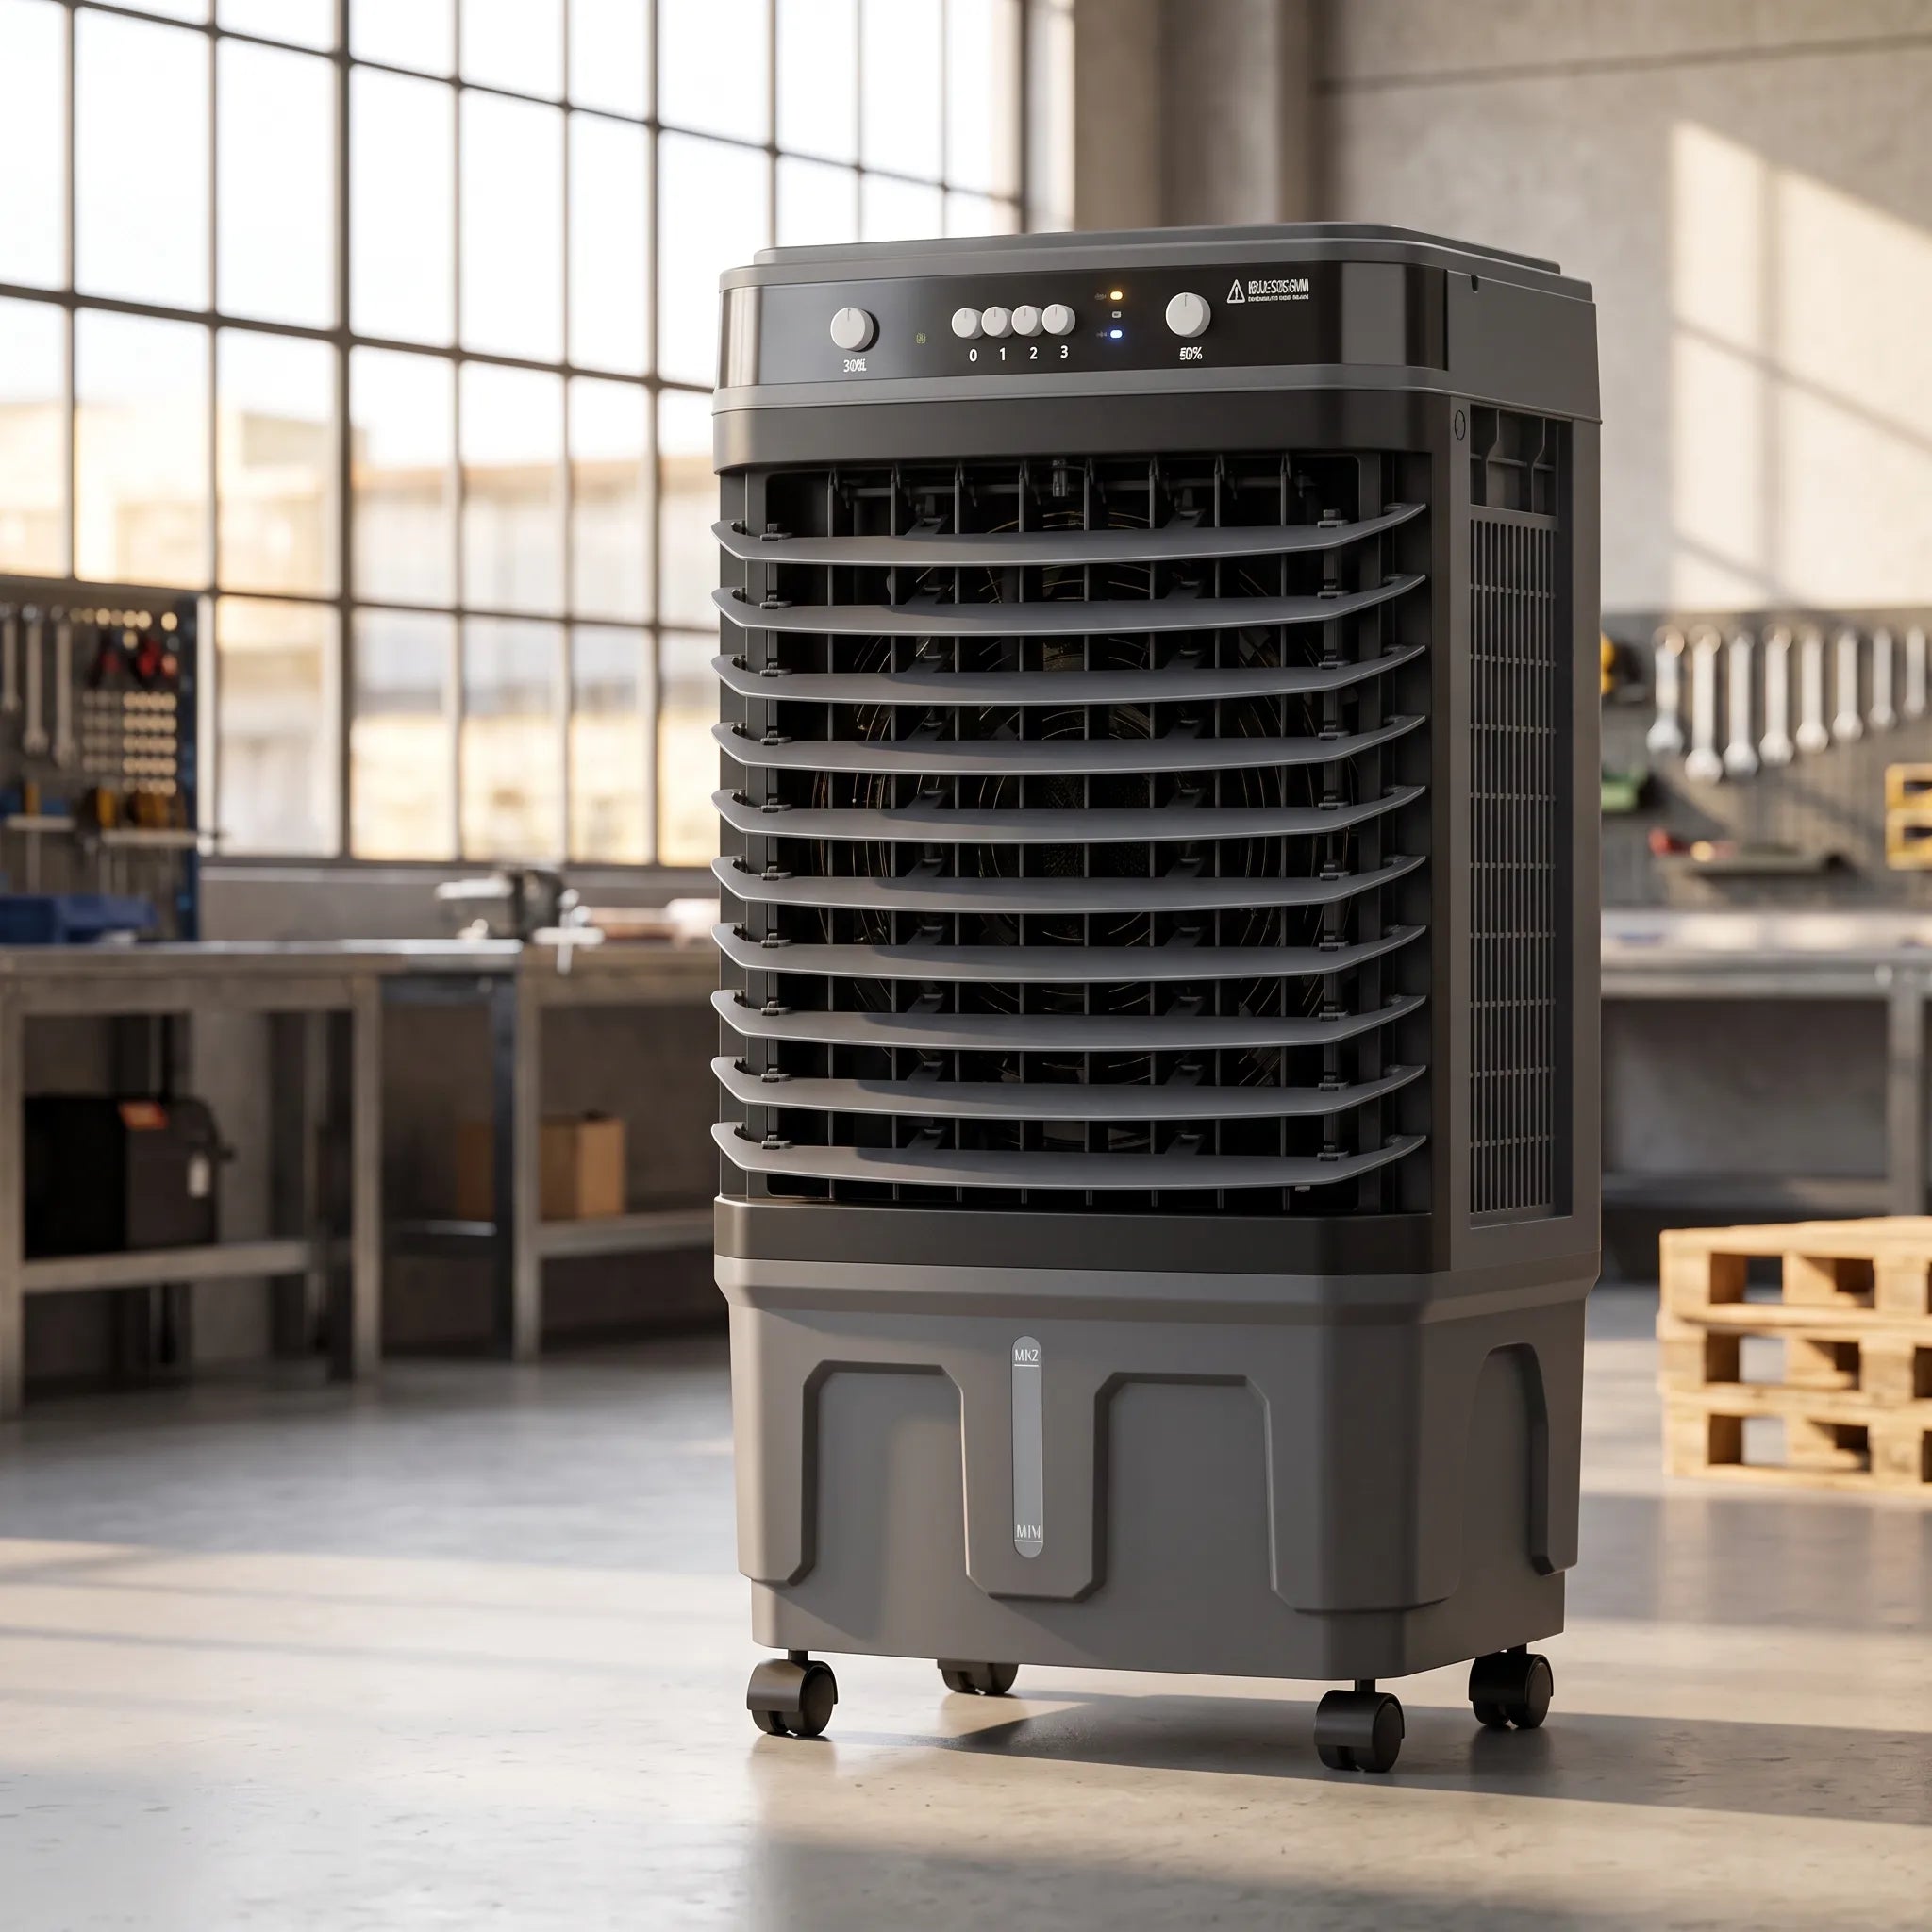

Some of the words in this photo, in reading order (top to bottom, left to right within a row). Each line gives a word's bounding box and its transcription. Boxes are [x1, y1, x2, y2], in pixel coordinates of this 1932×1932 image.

[969, 348, 978, 362] 0
[999, 347, 1006, 361] 1
[1029, 346, 1038, 359] 2
[1060, 344, 1069, 358] 3
